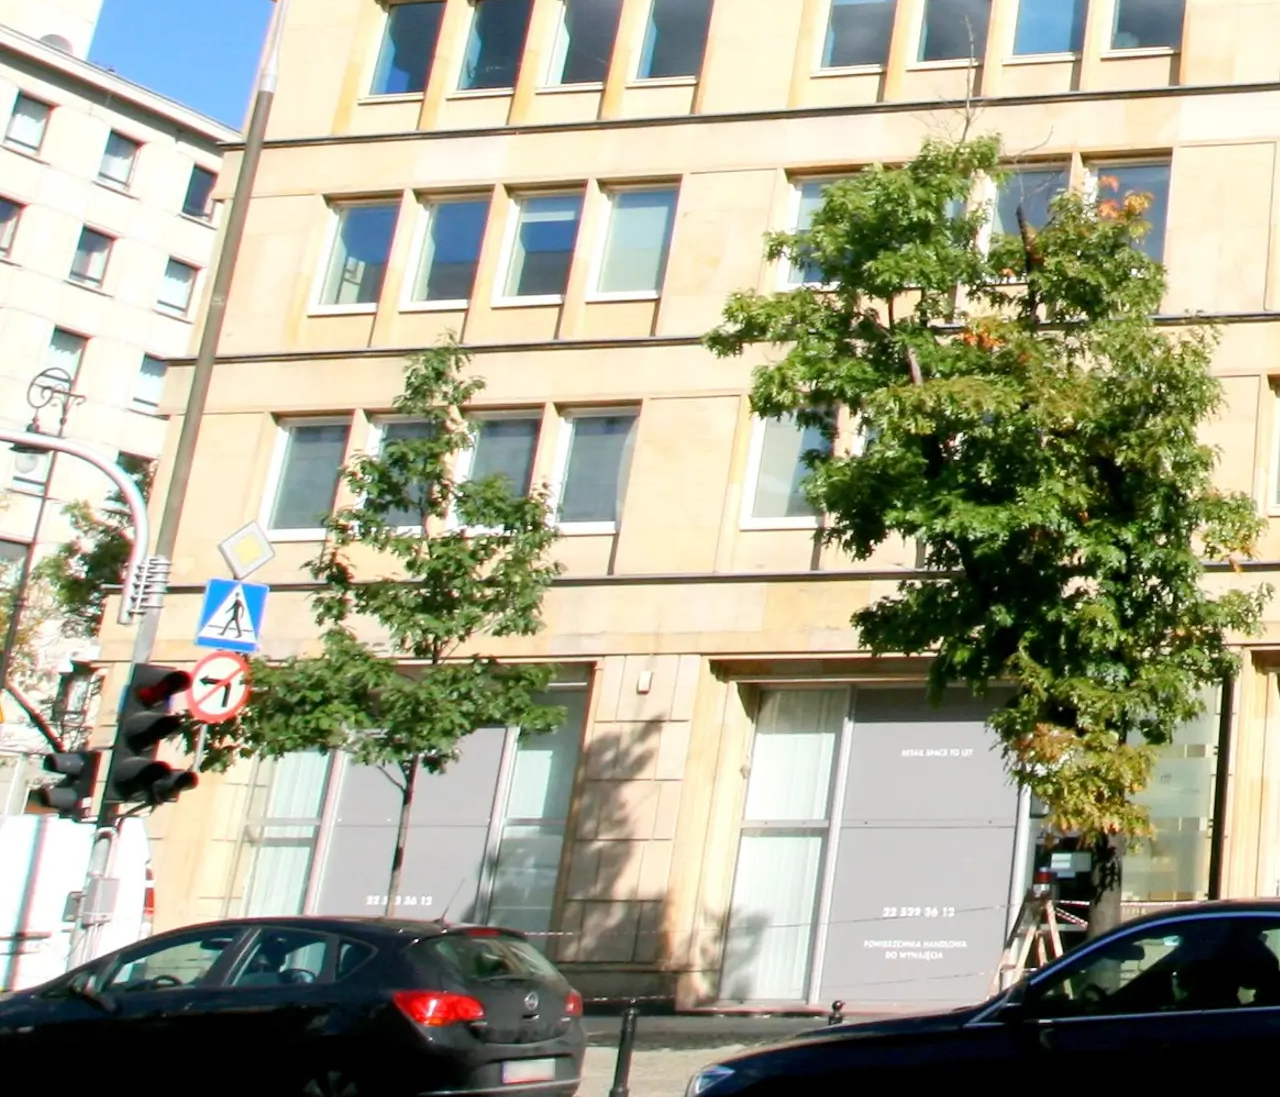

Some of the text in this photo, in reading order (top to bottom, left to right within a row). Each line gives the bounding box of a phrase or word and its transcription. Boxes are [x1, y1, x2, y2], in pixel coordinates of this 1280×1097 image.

[882, 906, 898, 917] 22
[924, 906, 939, 918] 36
[942, 906, 955, 918] 12
